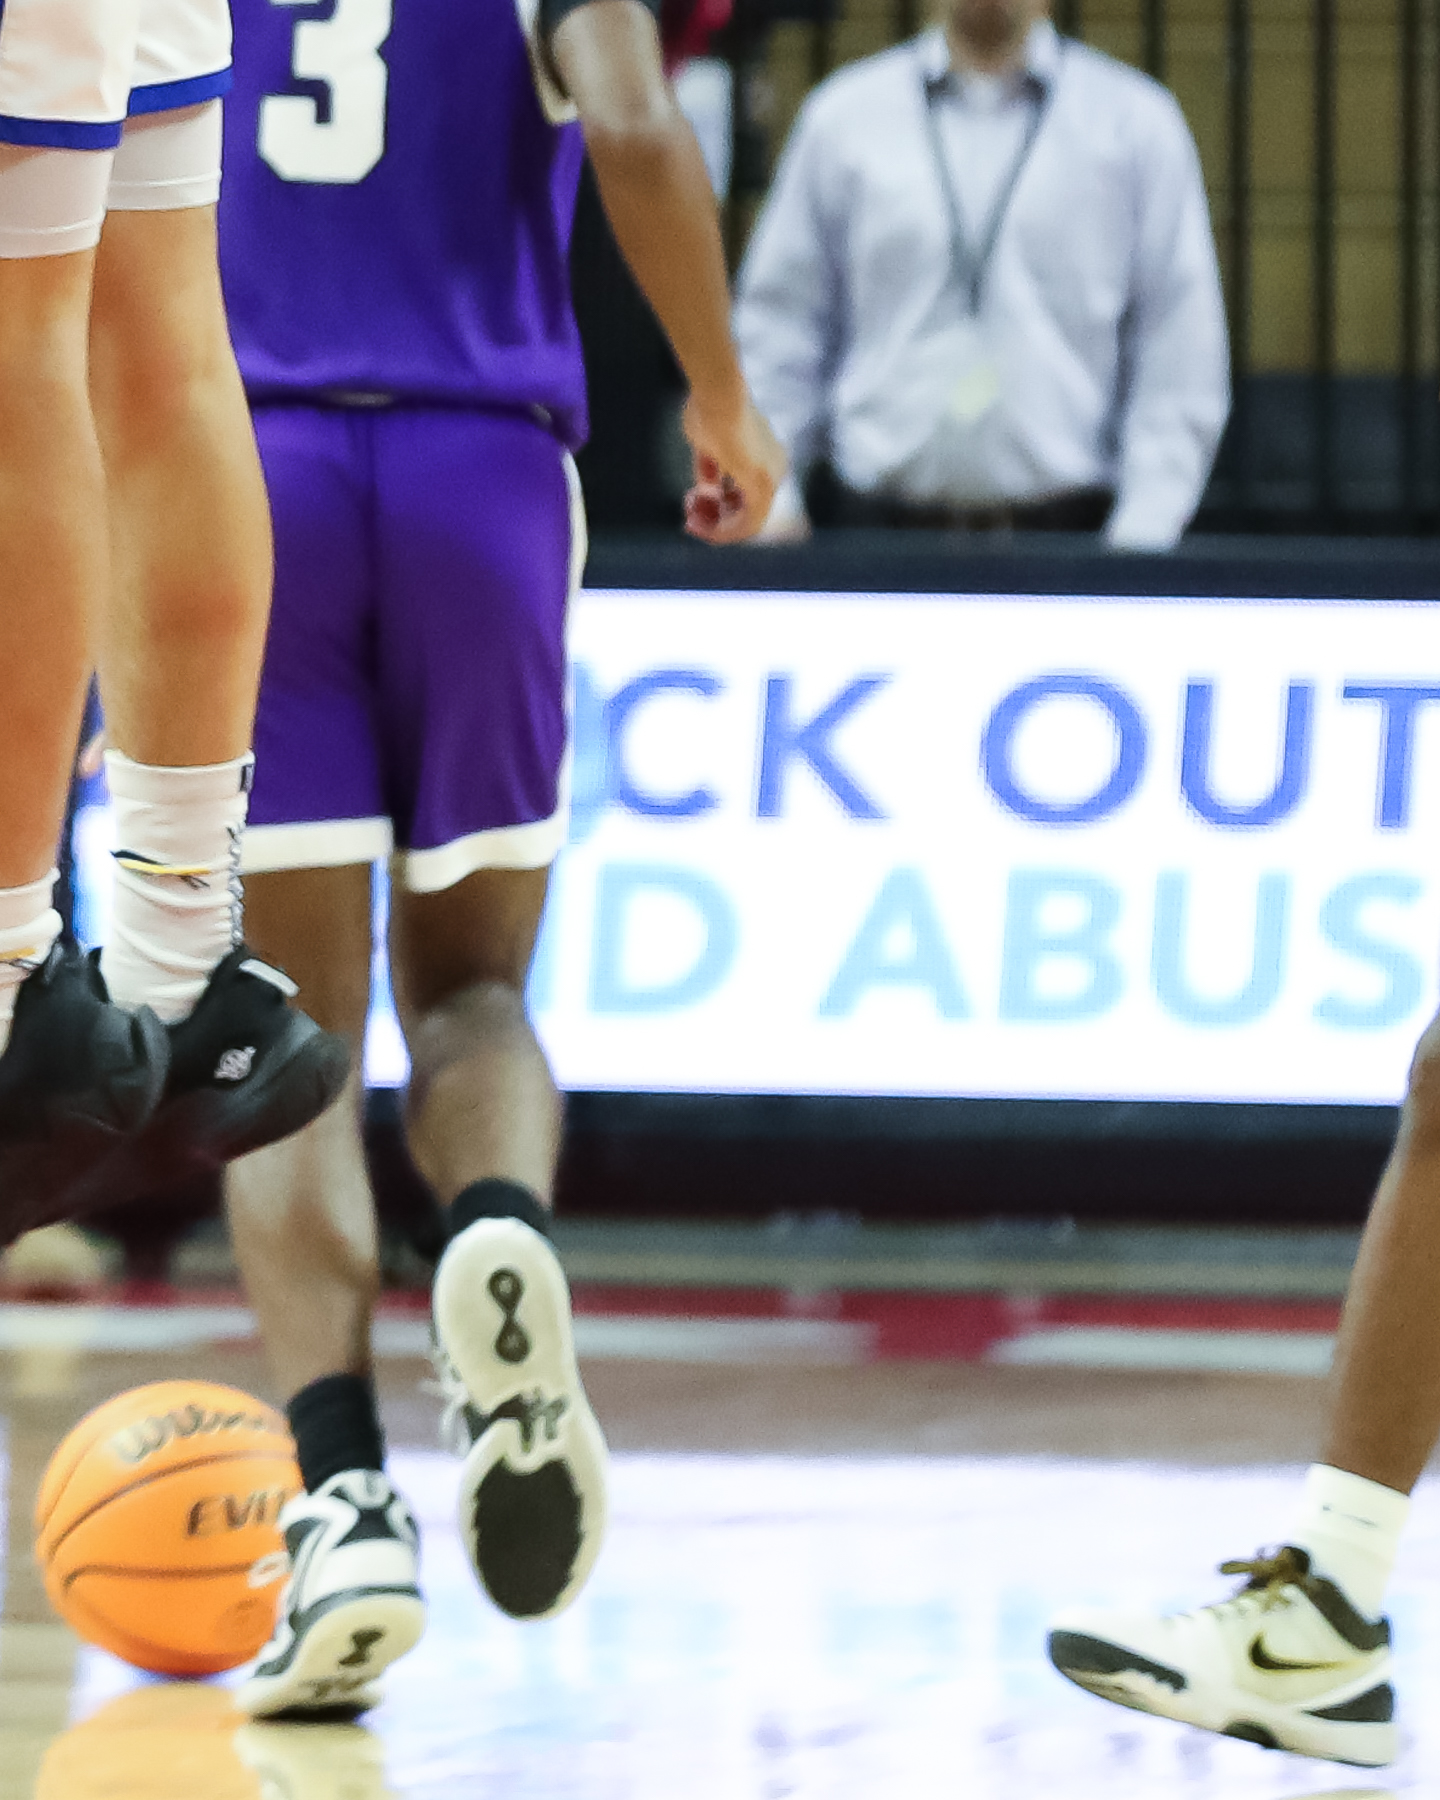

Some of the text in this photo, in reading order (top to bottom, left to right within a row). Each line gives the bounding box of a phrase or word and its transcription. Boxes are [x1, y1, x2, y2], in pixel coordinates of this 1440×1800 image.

[602, 666, 1440, 832] CK OUT
[815, 866, 1426, 1030] ABUS
